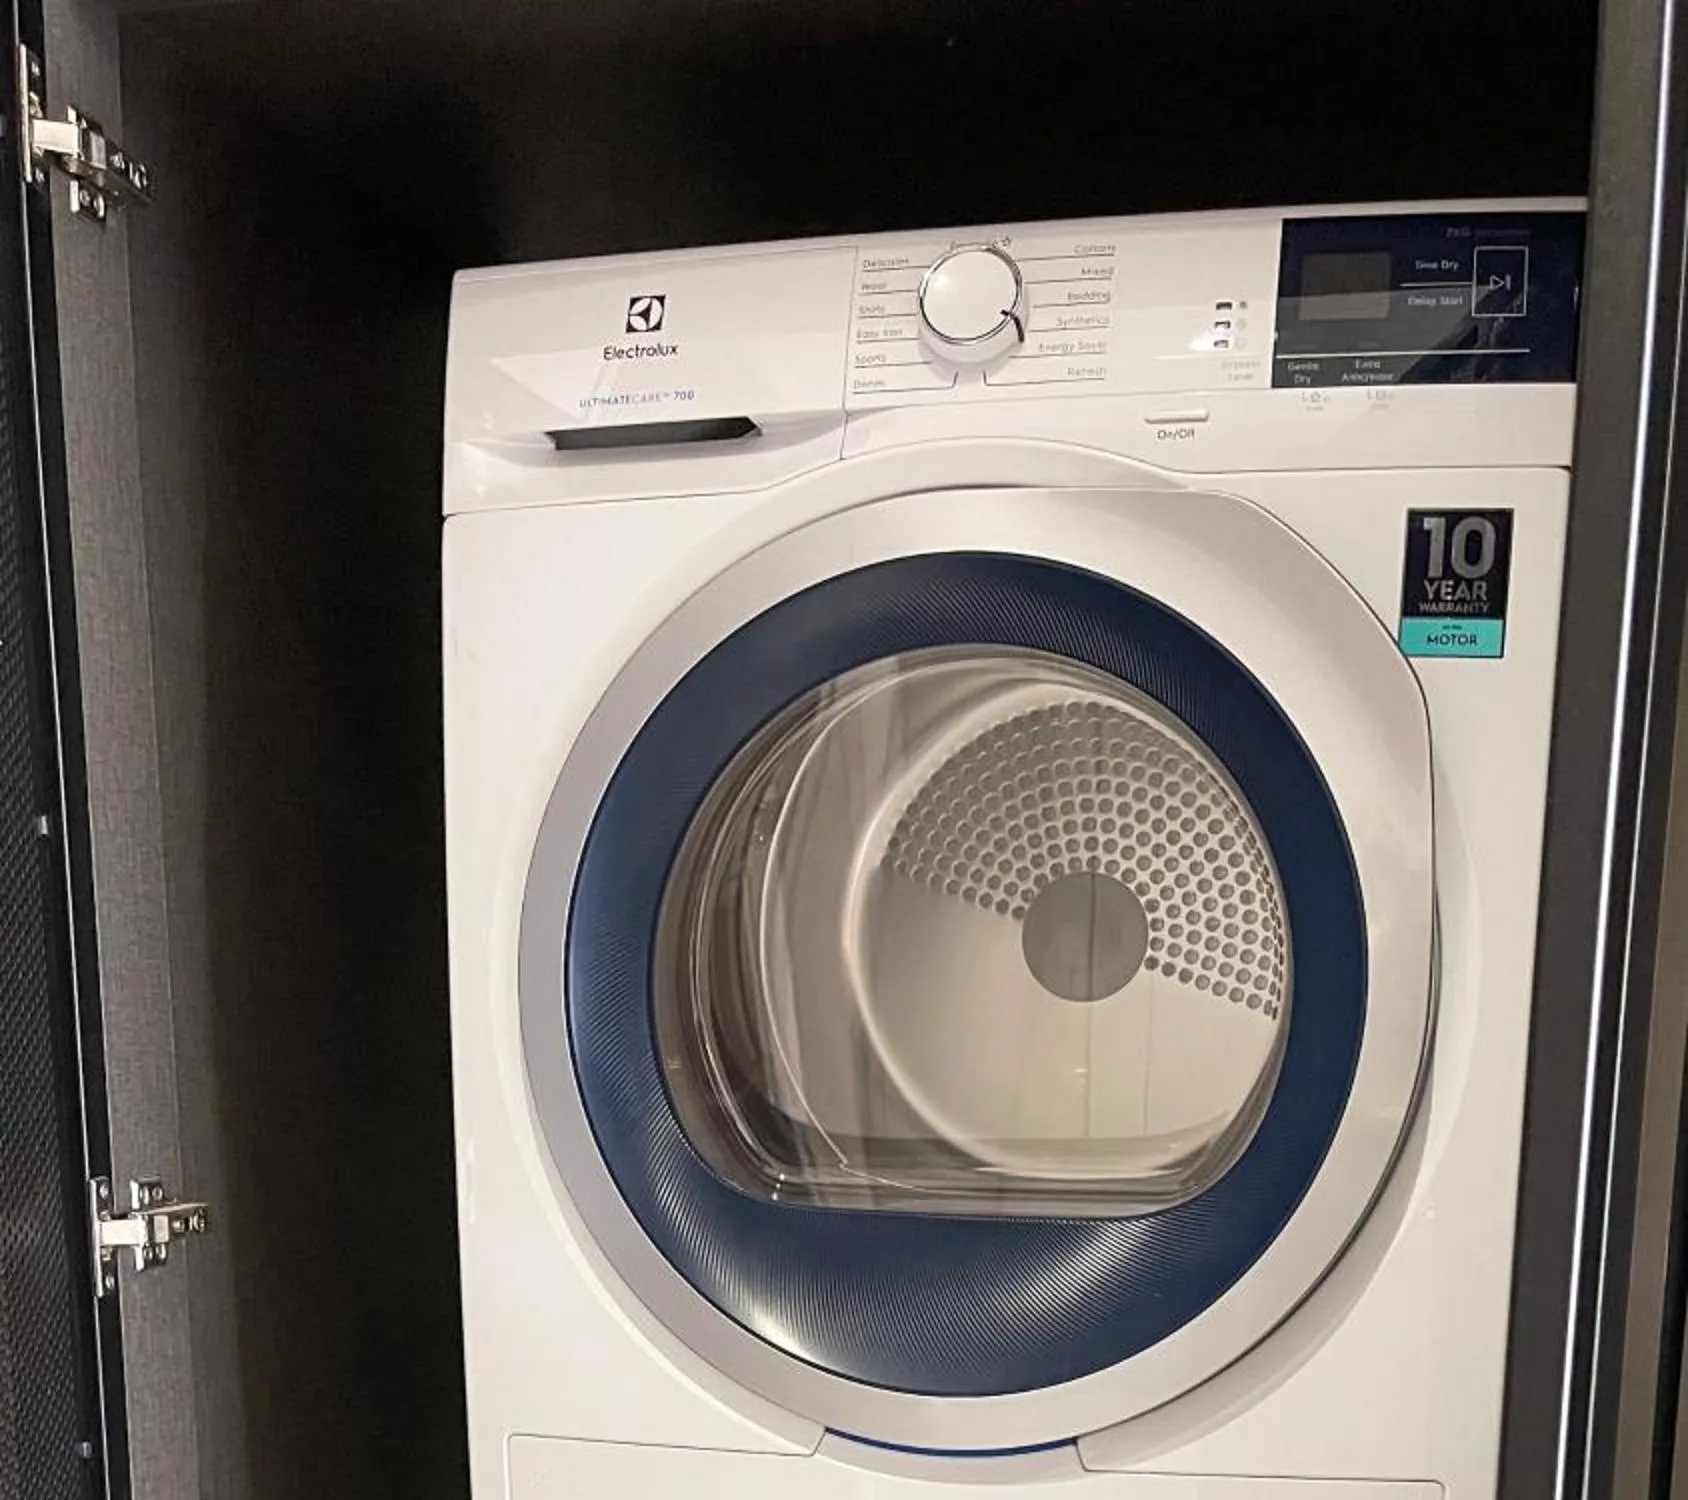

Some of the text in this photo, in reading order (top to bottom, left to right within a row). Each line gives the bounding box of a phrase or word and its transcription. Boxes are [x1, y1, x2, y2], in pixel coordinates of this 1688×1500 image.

[1441, 260, 1459, 271] Dry
[603, 343, 679, 361] Electrolux
[1294, 373, 1311, 385] Dry
[673, 391, 695, 401] 700
[1157, 428, 1195, 441] On/Off
[1422, 515, 1497, 579] 10
[1423, 579, 1489, 601] YEAR
[1418, 602, 1490, 613] WARRANTY
[1426, 634, 1478, 646] MOTOR
